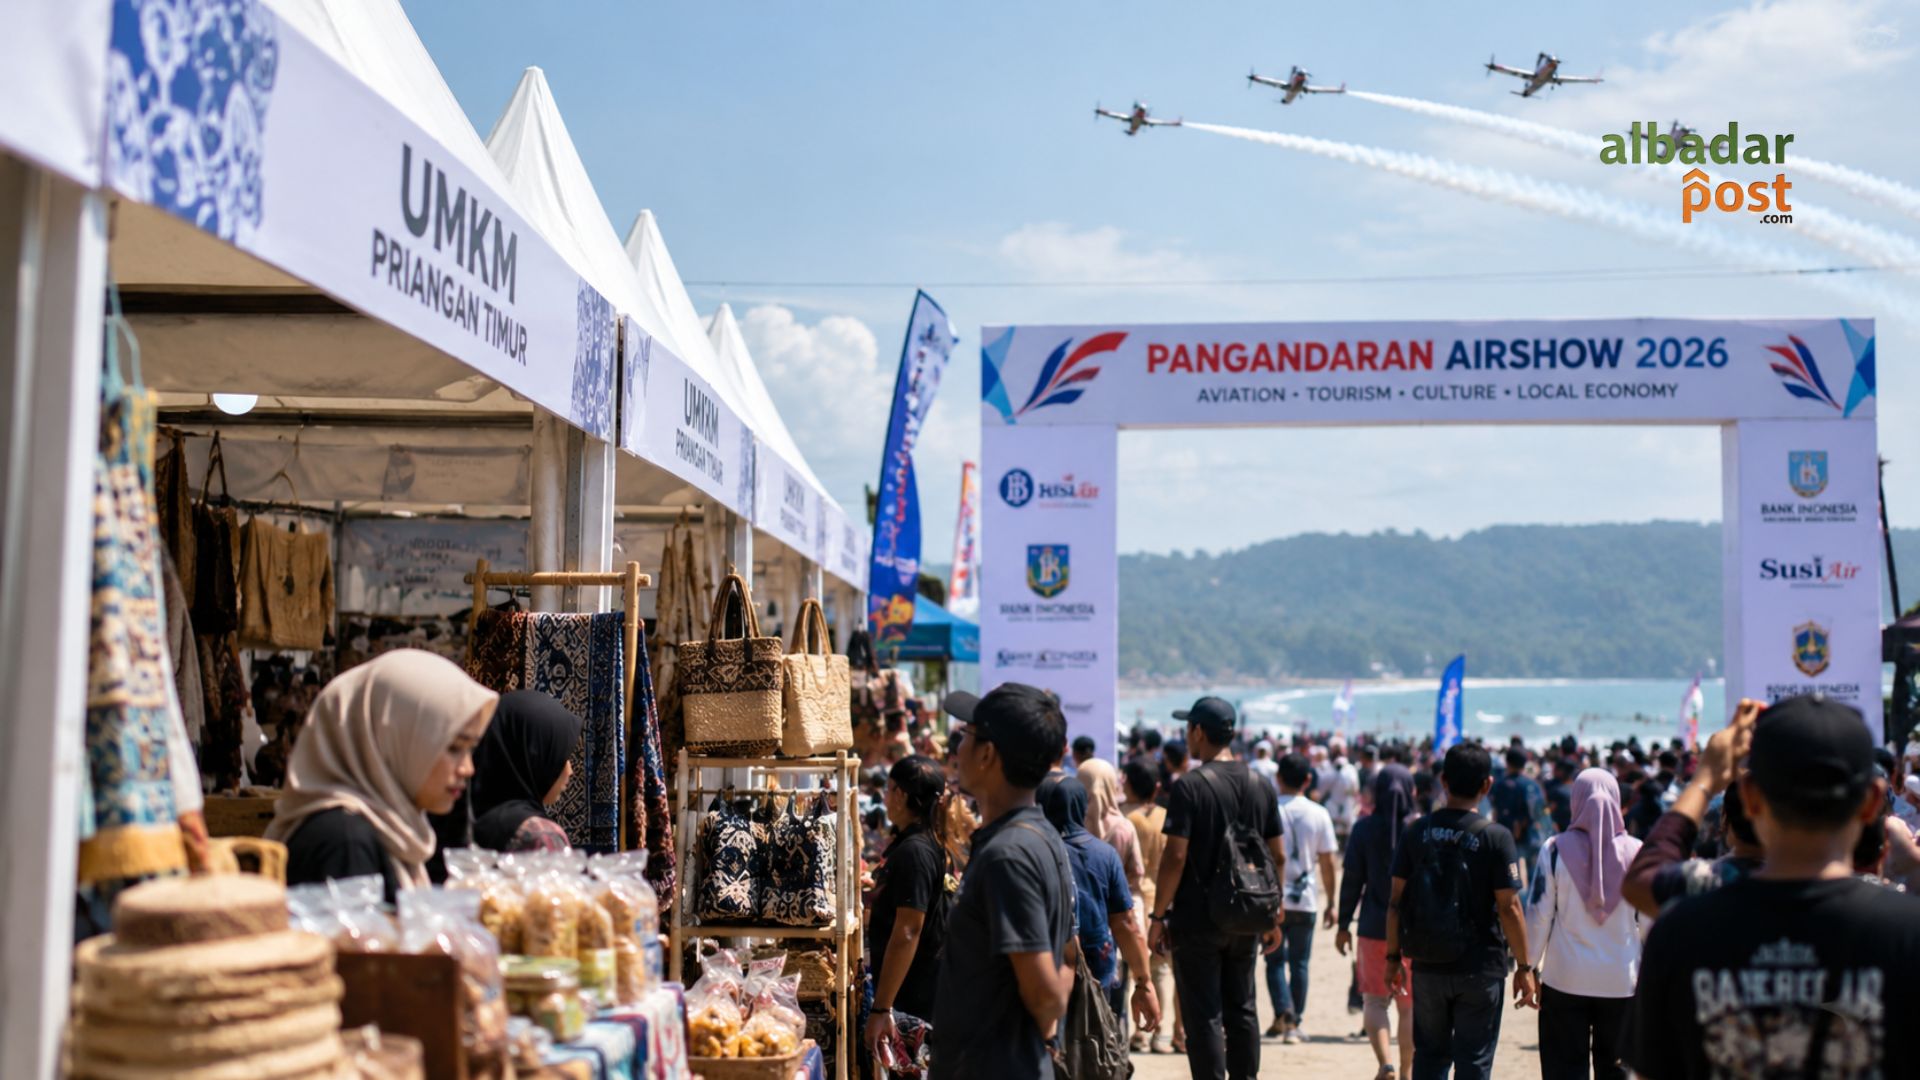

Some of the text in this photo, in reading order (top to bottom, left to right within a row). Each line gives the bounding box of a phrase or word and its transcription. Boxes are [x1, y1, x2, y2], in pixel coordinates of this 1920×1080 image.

[401, 141, 518, 306] UMKM
[372, 227, 528, 367] PRIANGAN TIMUR
[1147, 337, 1729, 373] PANGANDARAN AIRSHOW 2026
[1198, 383, 1679, 402] AVIATION TOURISM CULTURE LOCAL ECONOMY
[1760, 555, 1822, 580] Susi
